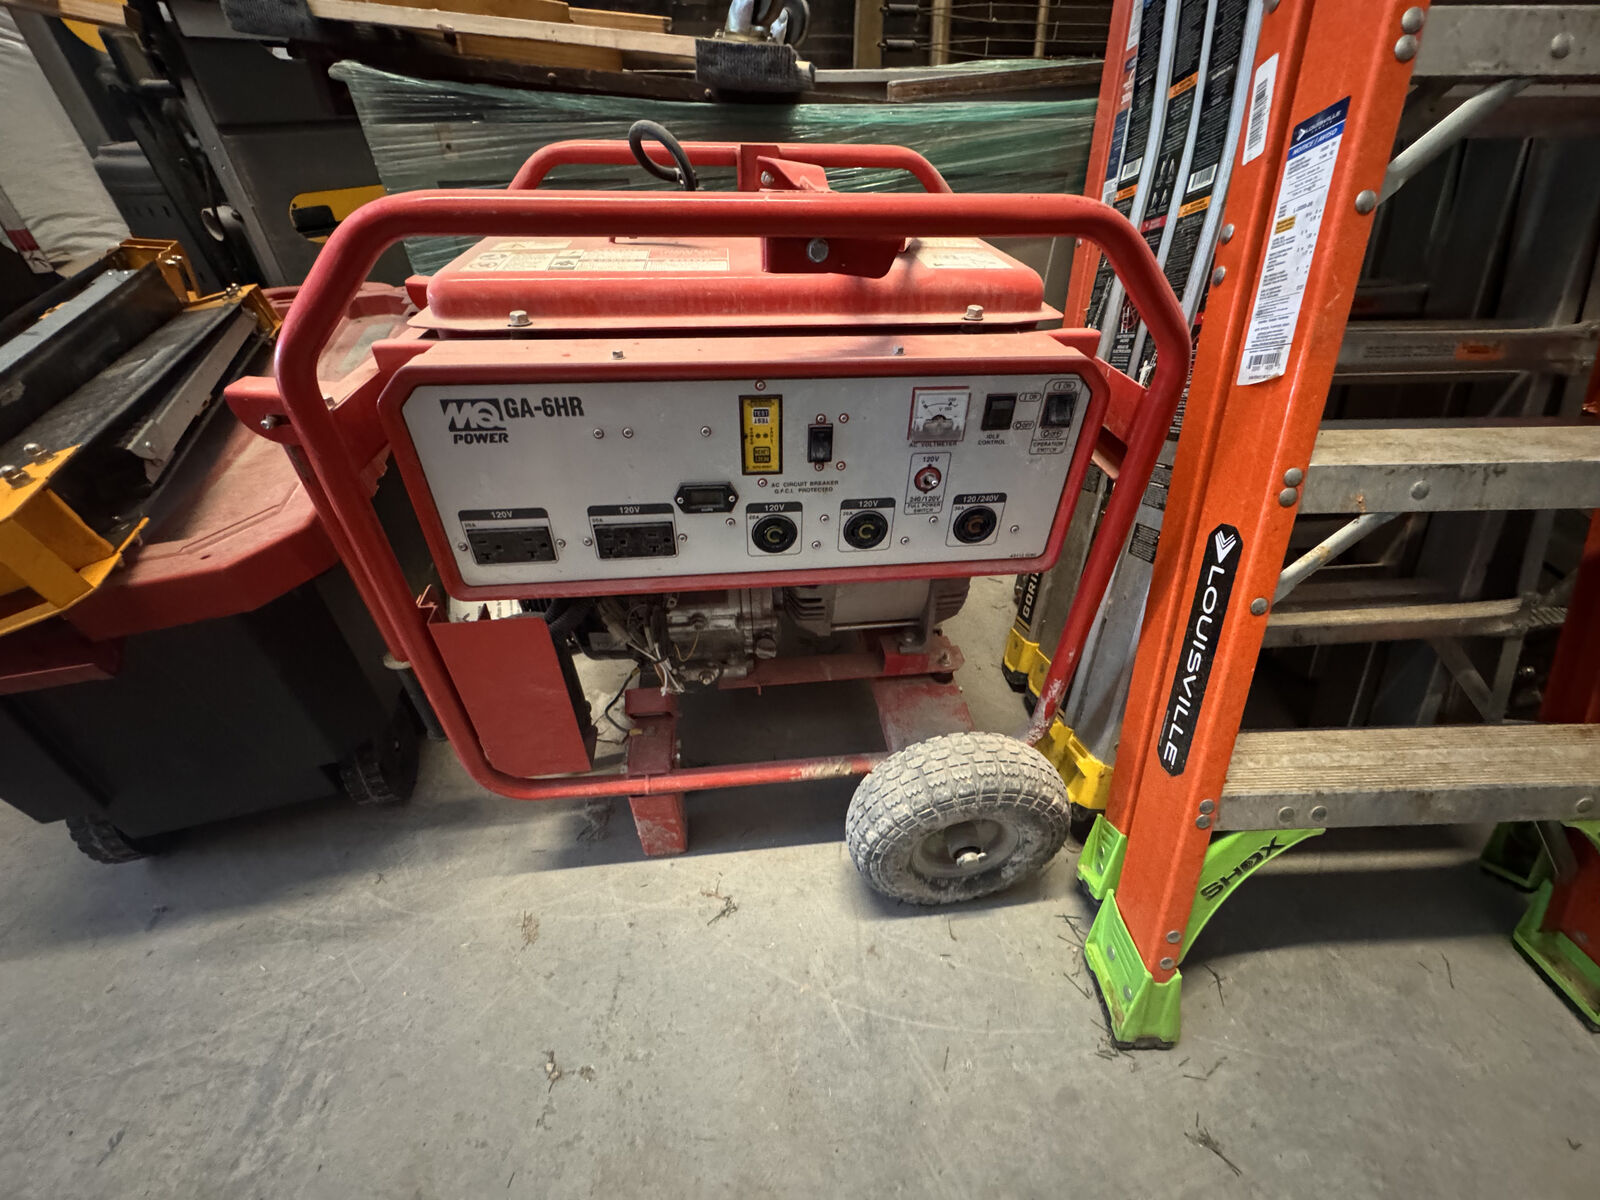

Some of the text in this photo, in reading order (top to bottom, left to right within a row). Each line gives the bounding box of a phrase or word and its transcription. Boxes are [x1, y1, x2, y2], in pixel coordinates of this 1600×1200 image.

[503, 396, 585, 419] GA-6HR
[440, 398, 507, 432] MQ
[453, 432, 509, 445] POWER
[921, 440, 957, 448] VOLTMETER
[859, 500, 879, 508] 120V
[963, 495, 1000, 503] 120/240V
[619, 506, 641, 514] 120V
[764, 504, 785, 512] 120V
[491, 510, 513, 519] 120V
[1022, 572, 1039, 618] GORI
[1163, 564, 1225, 766] LOUISVILLE
[1200, 836, 1285, 901] SHOX
